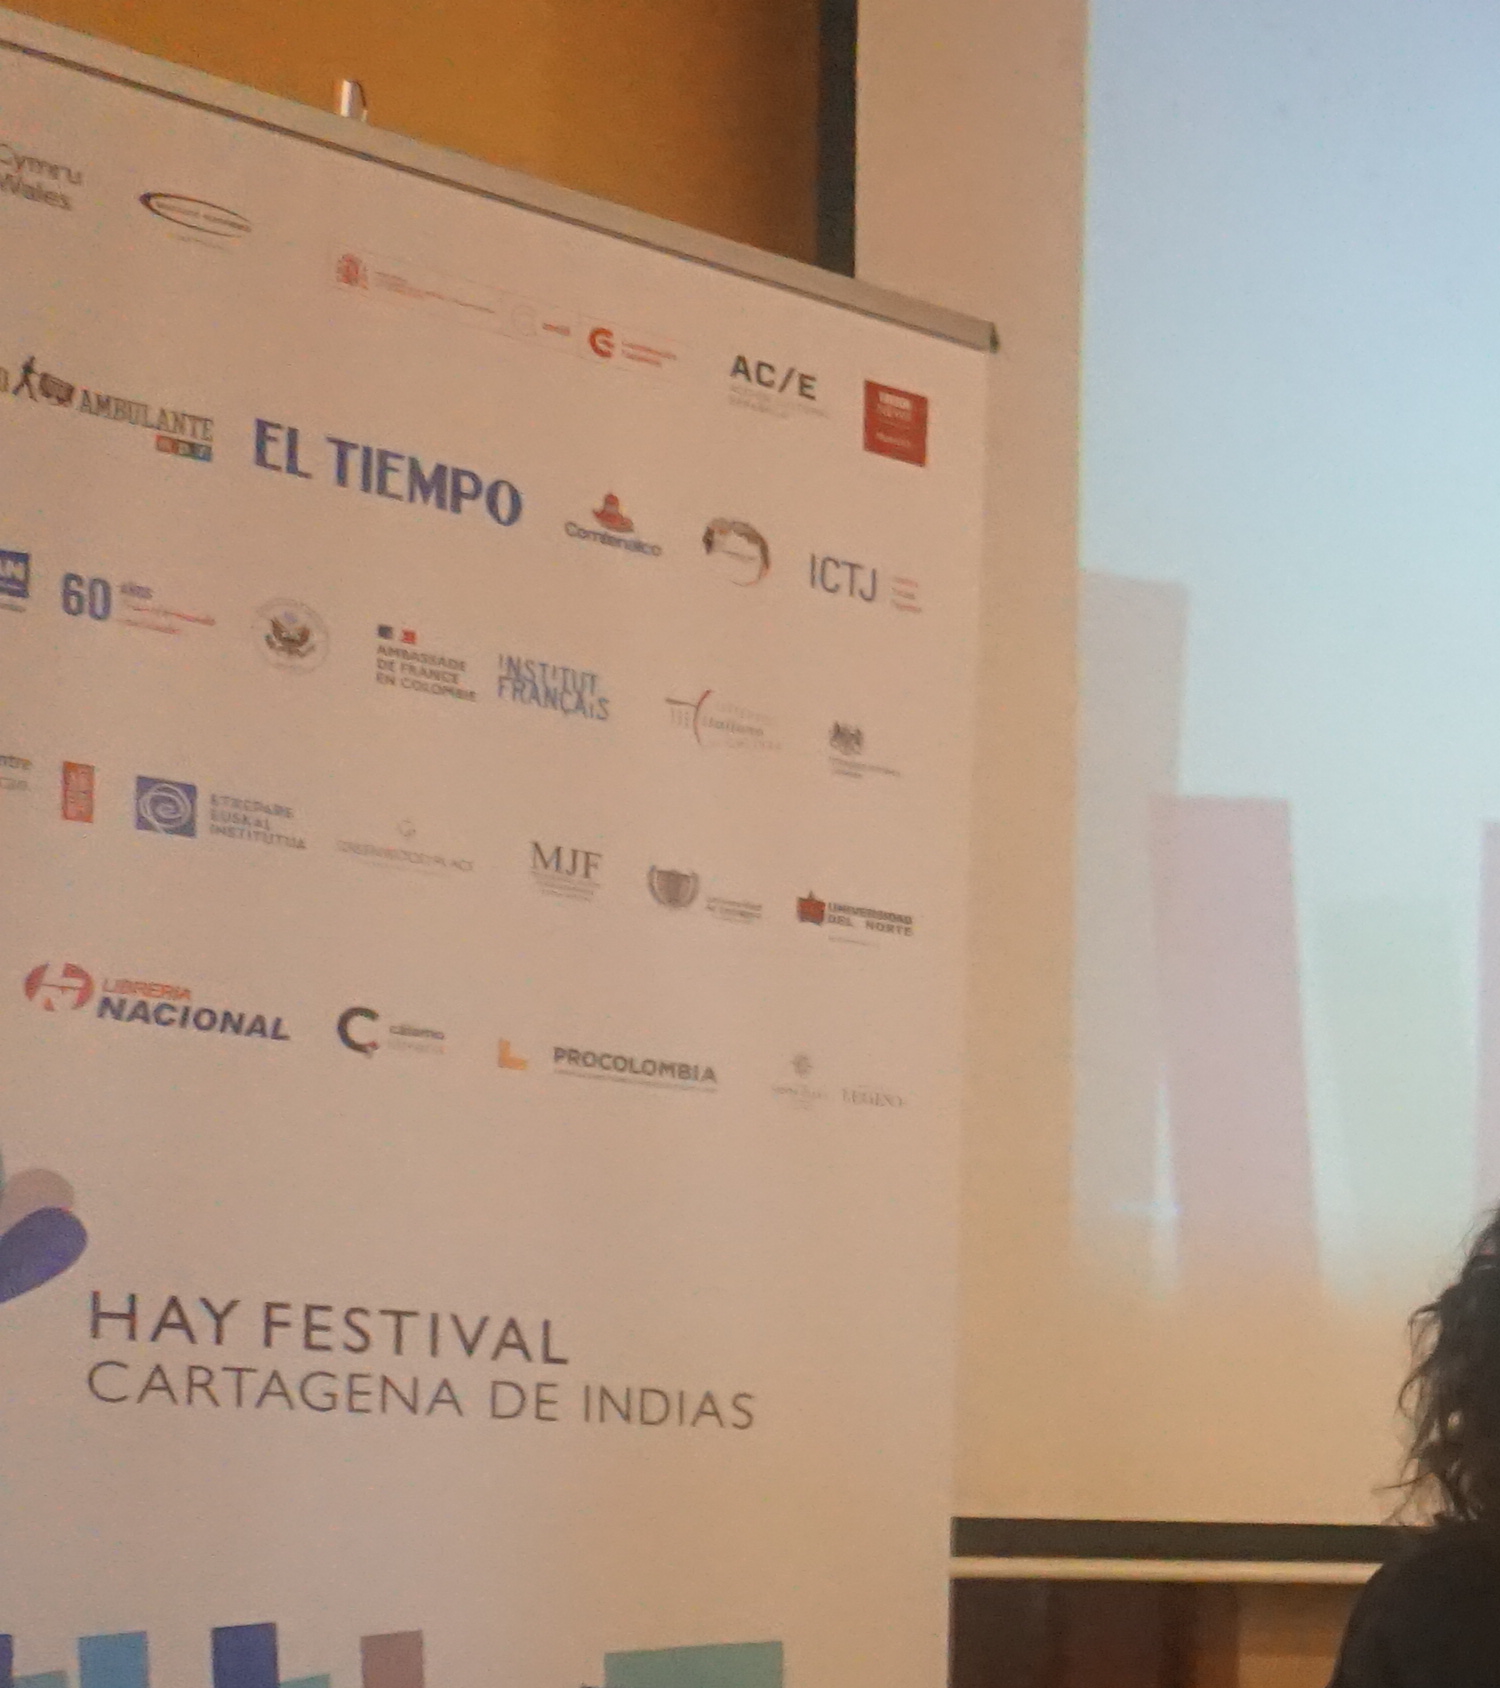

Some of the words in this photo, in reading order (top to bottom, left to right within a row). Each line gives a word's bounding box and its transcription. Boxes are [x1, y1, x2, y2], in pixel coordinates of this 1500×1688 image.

[730, 354, 817, 401] AC/E
[80, 389, 215, 442] AMBULANTE
[254, 417, 313, 480] EL
[326, 436, 523, 528] TIEMPO
[62, 572, 112, 622] 60
[809, 552, 878, 603] ICTJ
[498, 653, 598, 696] INSTITUT
[530, 840, 604, 880] MJF
[96, 996, 291, 1042] NACIONAL
[553, 1046, 718, 1085] PROCOLOMBIA
[90, 1289, 241, 1347] HAY
[262, 1301, 570, 1367] FESTIVAL
[87, 1360, 465, 1418] CARTAGENA
[490, 1378, 561, 1423] DE
[583, 1383, 757, 1432] INDIAS
